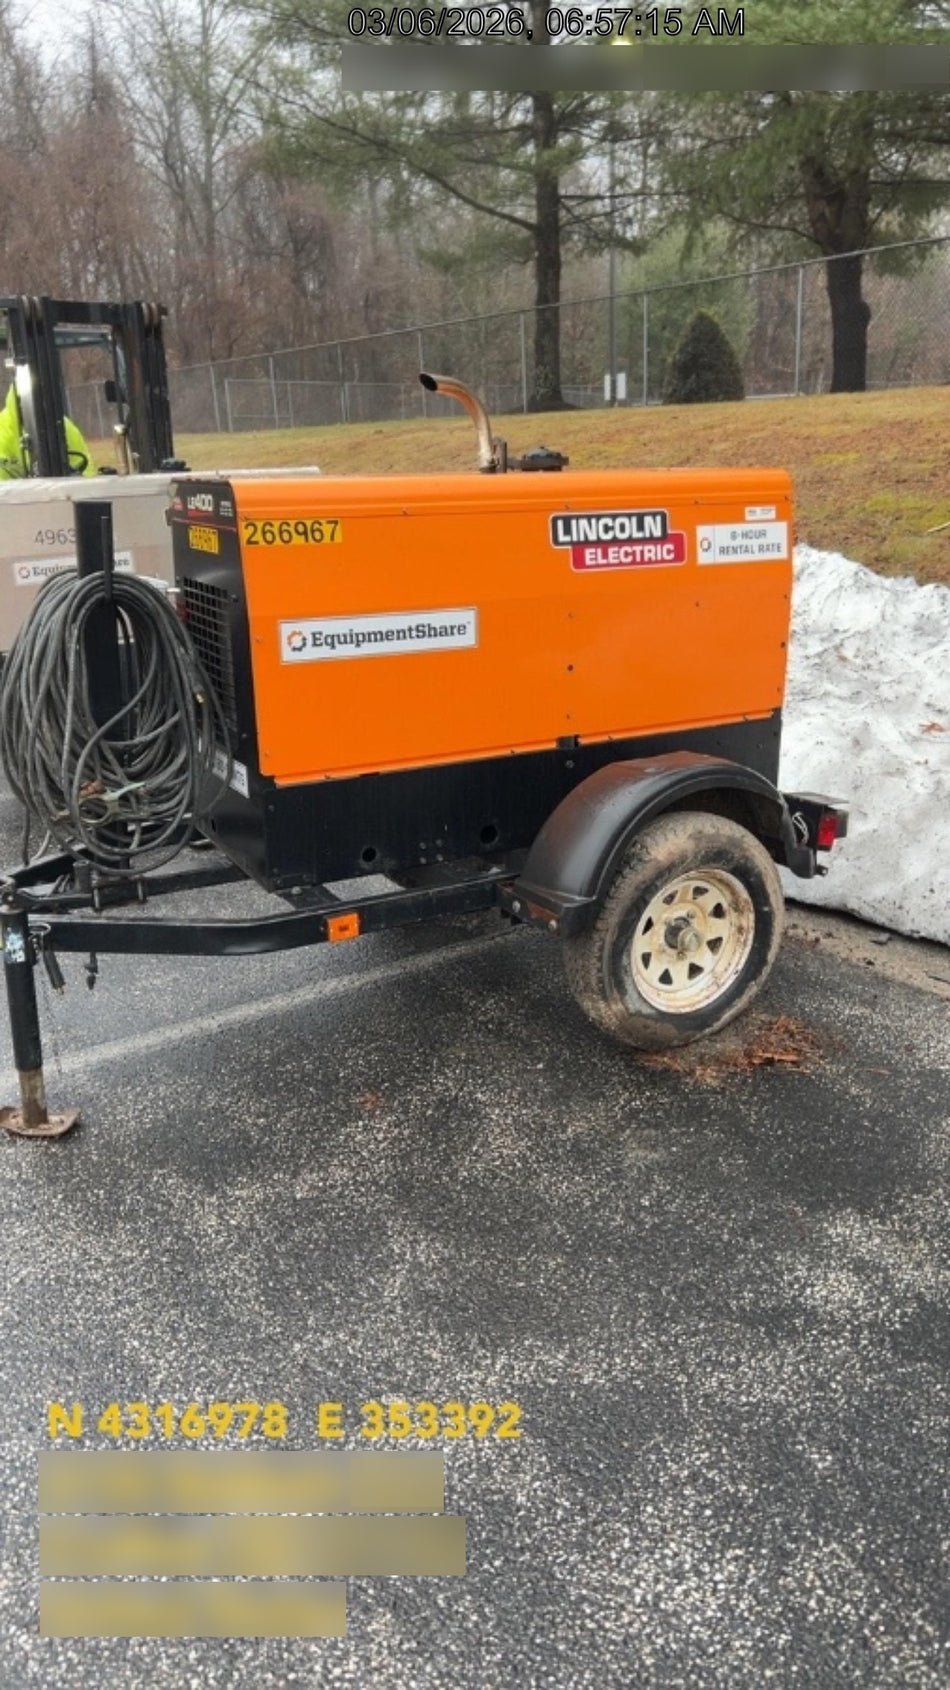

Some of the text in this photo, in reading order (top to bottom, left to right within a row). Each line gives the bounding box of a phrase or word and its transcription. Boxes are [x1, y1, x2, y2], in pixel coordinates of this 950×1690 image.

[244, 520, 339, 545] 266967
[556, 515, 662, 543] LINCOLN
[584, 544, 675, 566] ELECTRIC
[719, 543, 782, 556] RENTAL RATE
[311, 623, 467, 650] EquipmentShare
